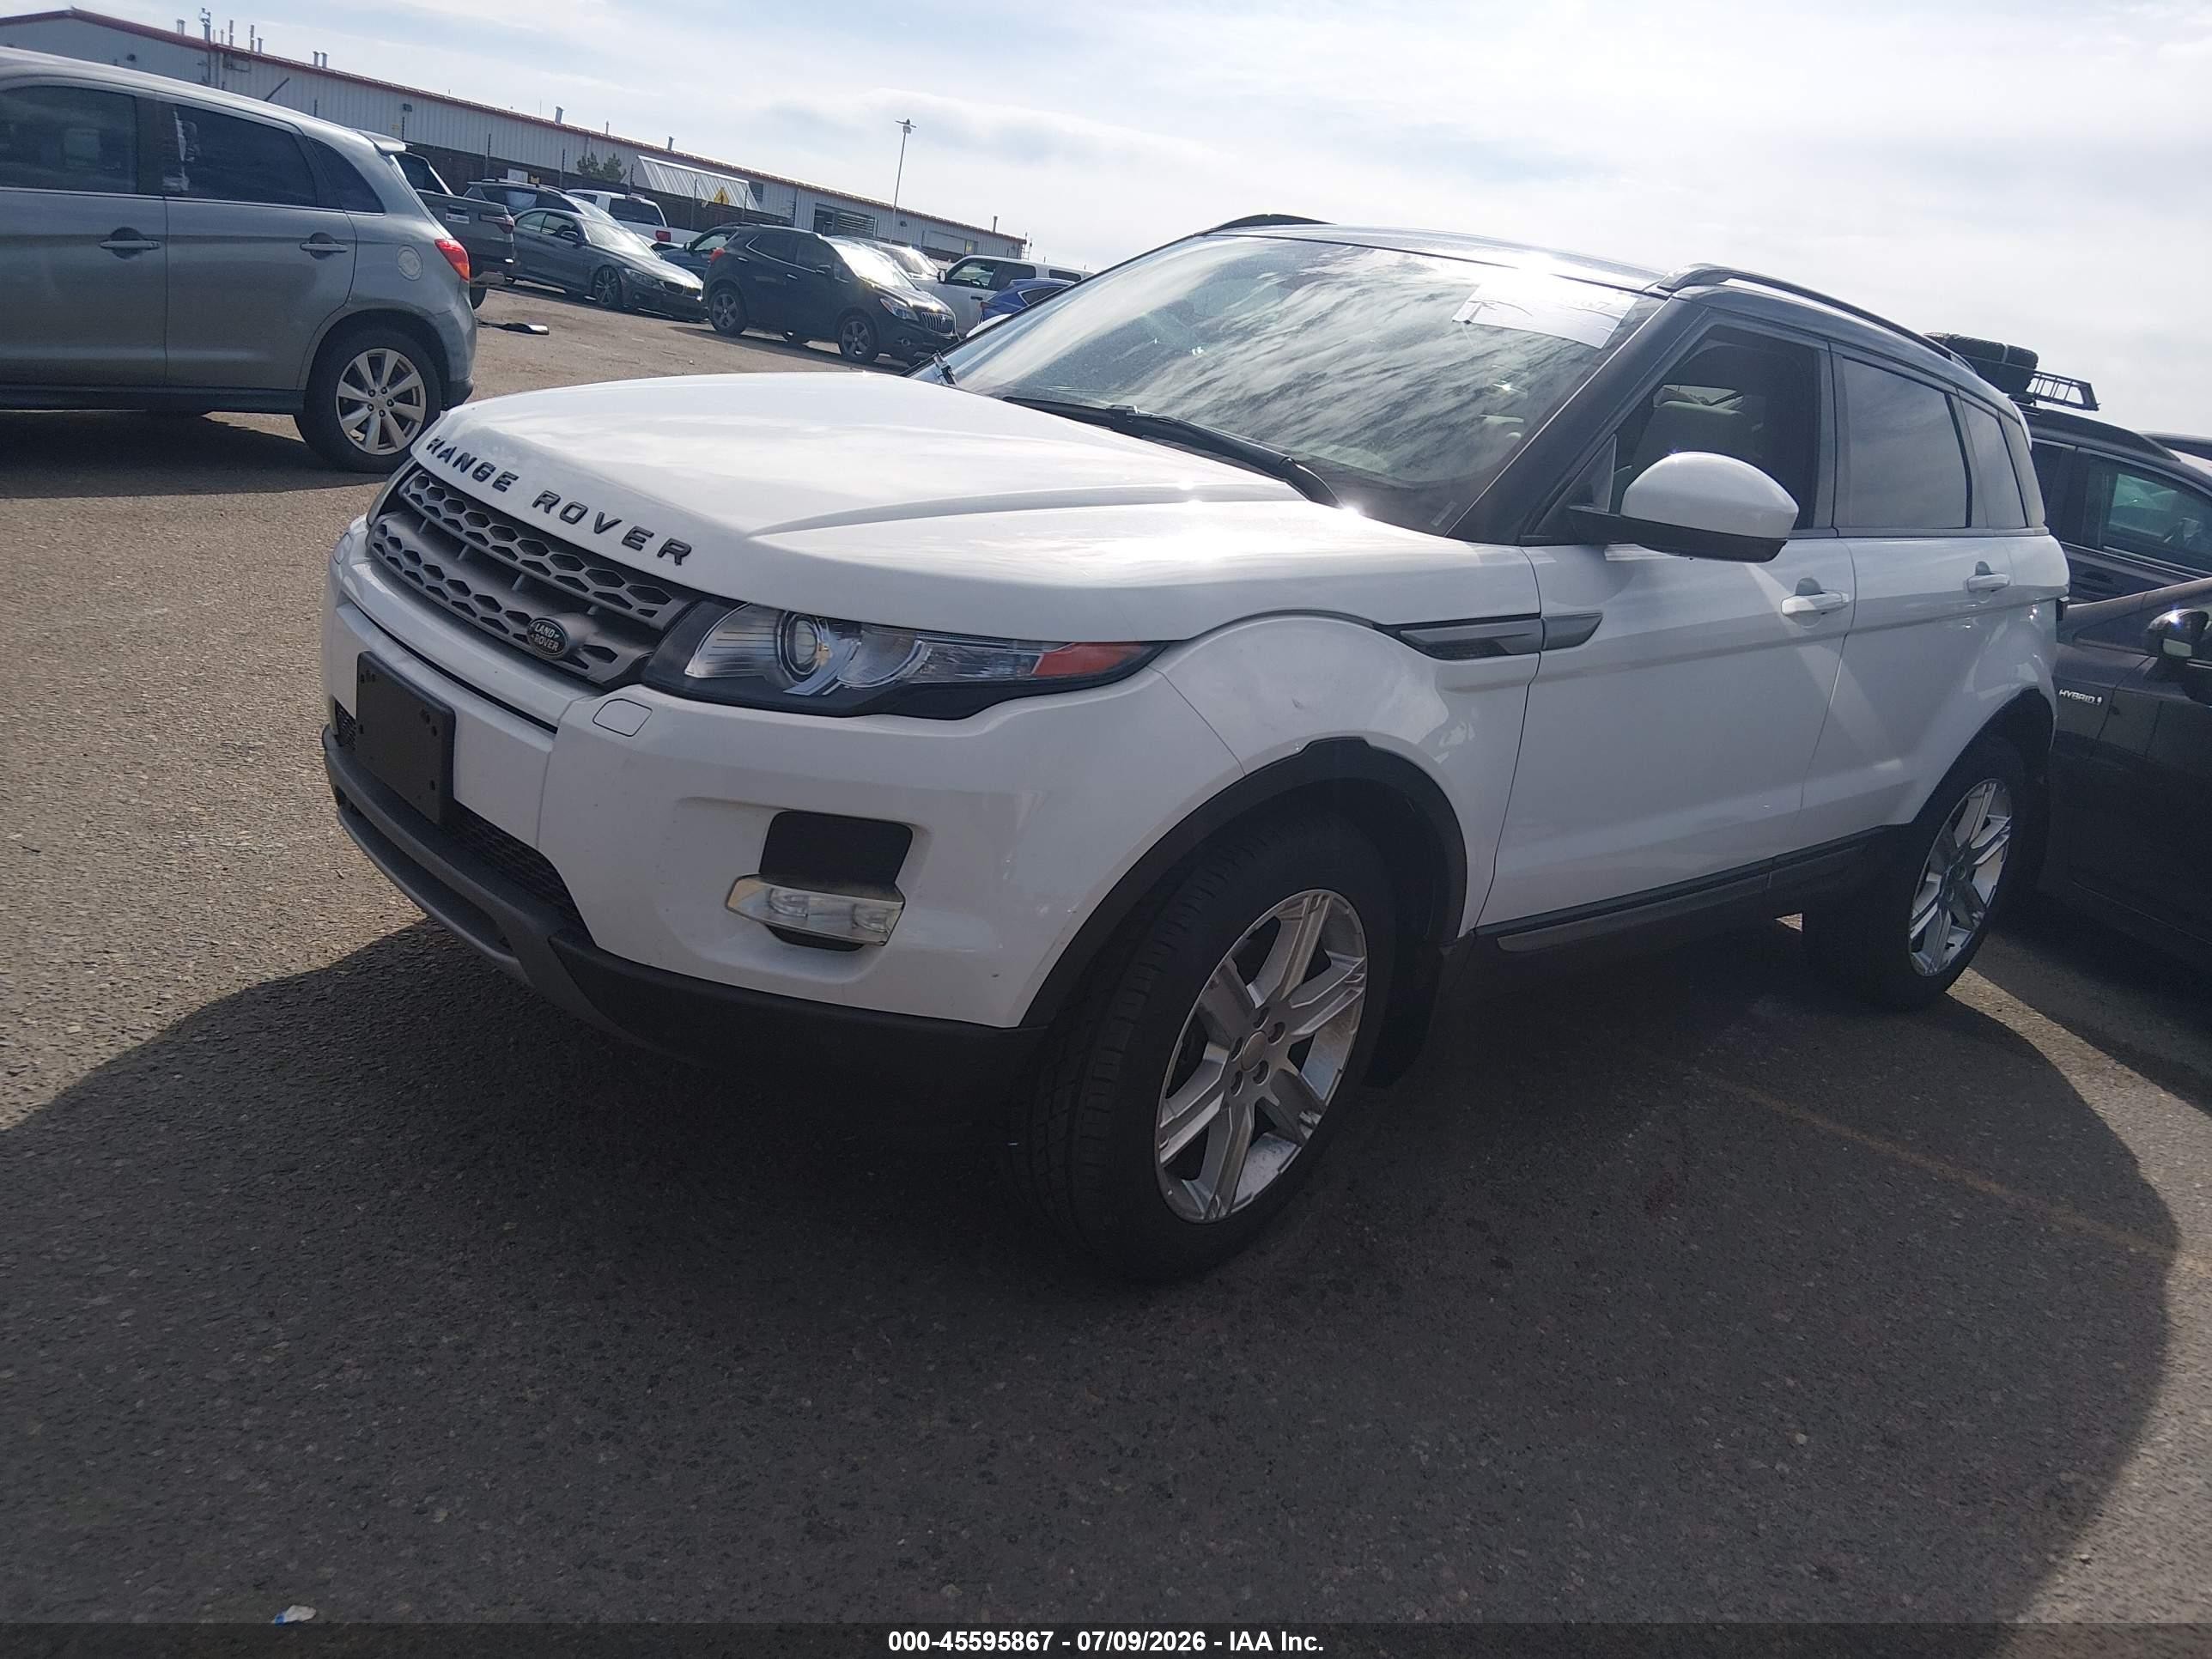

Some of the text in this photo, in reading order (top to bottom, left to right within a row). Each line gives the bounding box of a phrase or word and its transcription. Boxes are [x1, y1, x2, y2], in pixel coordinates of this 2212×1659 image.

[426, 435, 692, 567] RANGE ROVER
[534, 623, 556, 639] LAND
[534, 633, 559, 652] ROVER
[2058, 689, 2096, 704] HYBRID
